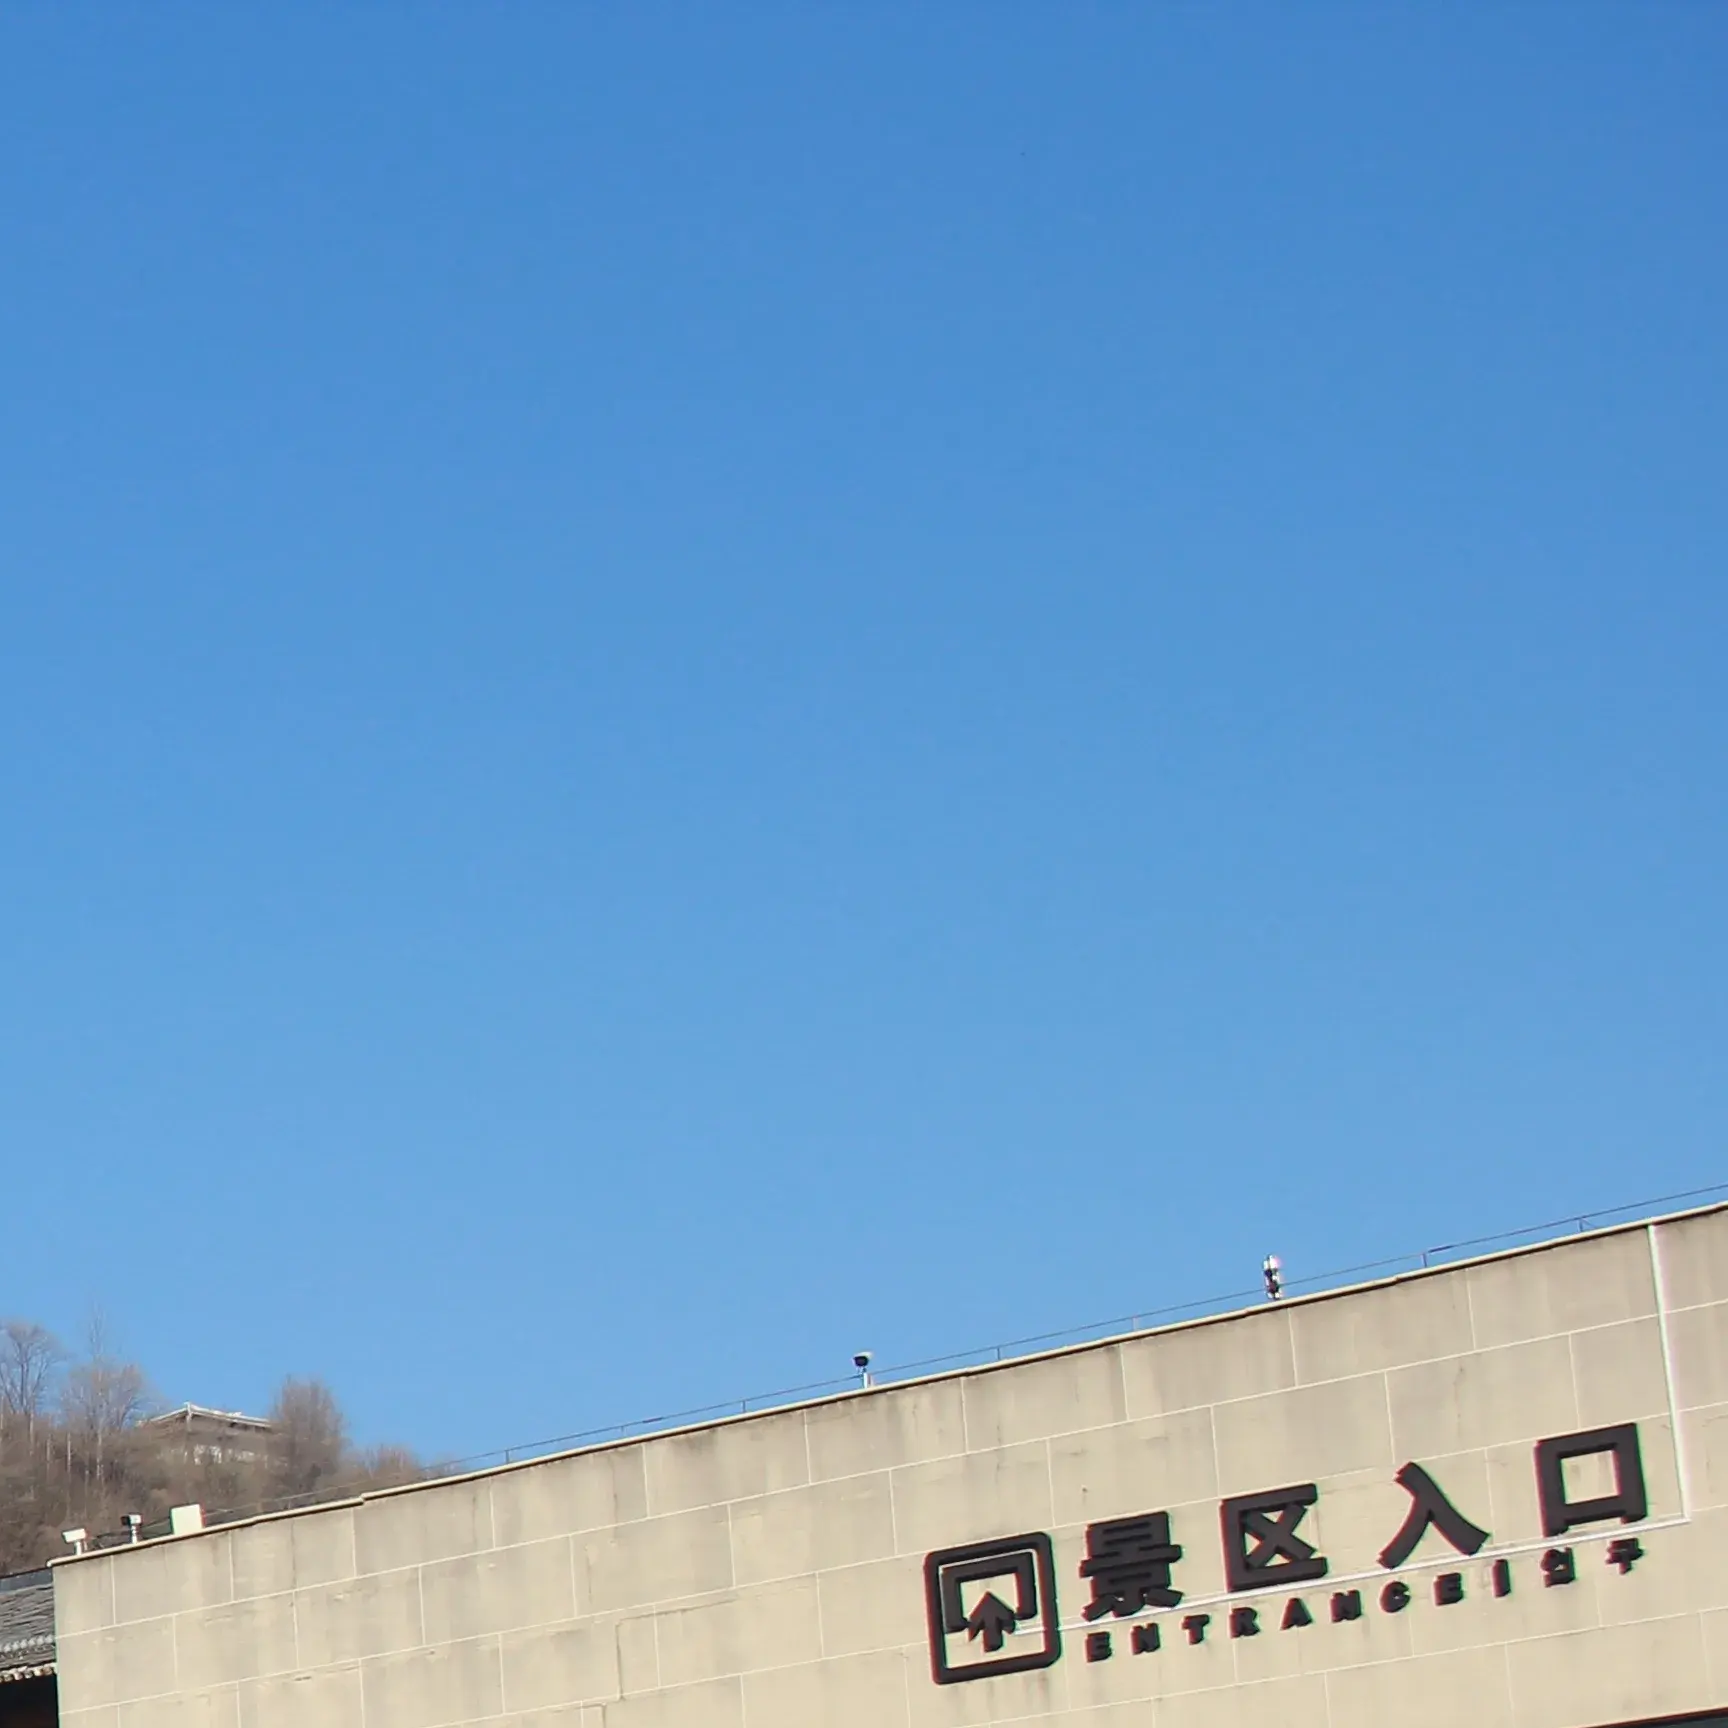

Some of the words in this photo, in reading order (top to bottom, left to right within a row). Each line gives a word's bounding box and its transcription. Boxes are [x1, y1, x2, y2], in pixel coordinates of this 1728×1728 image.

[1079, 1422, 1649, 1620] 景区入口
[1085, 1572, 1466, 1663] ENTRANCE
